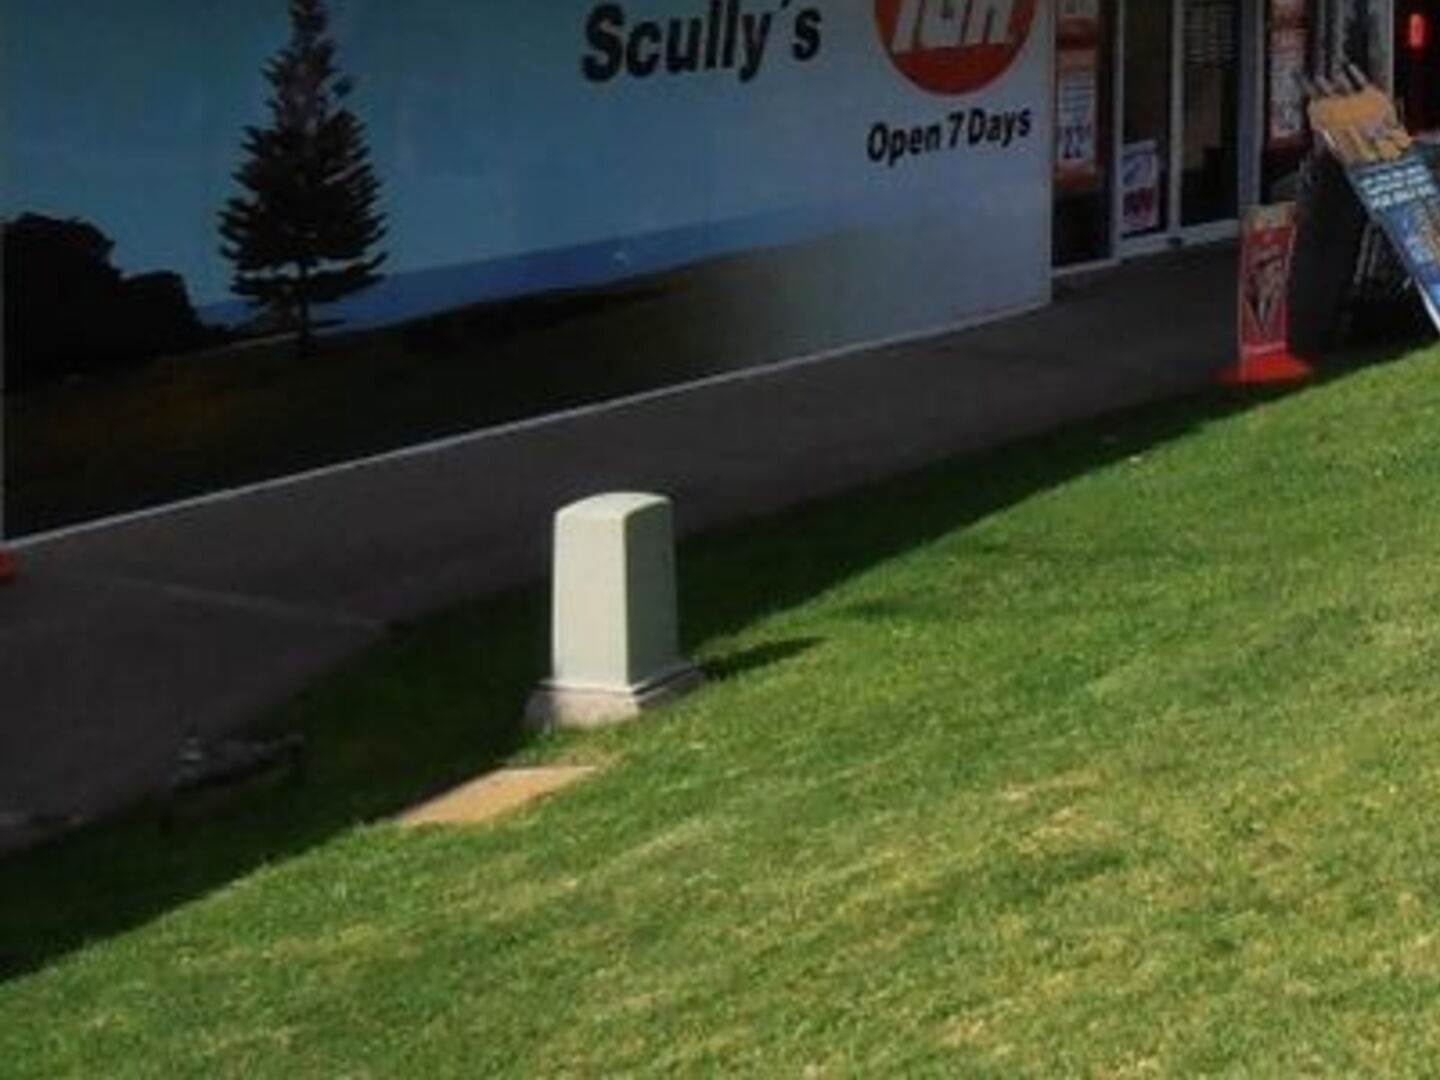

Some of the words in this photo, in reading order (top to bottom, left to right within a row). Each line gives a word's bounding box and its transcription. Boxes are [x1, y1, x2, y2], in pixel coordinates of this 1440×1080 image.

[866, 122, 942, 167] Open
[947, 110, 965, 149] 7
[968, 107, 1032, 149] Days
